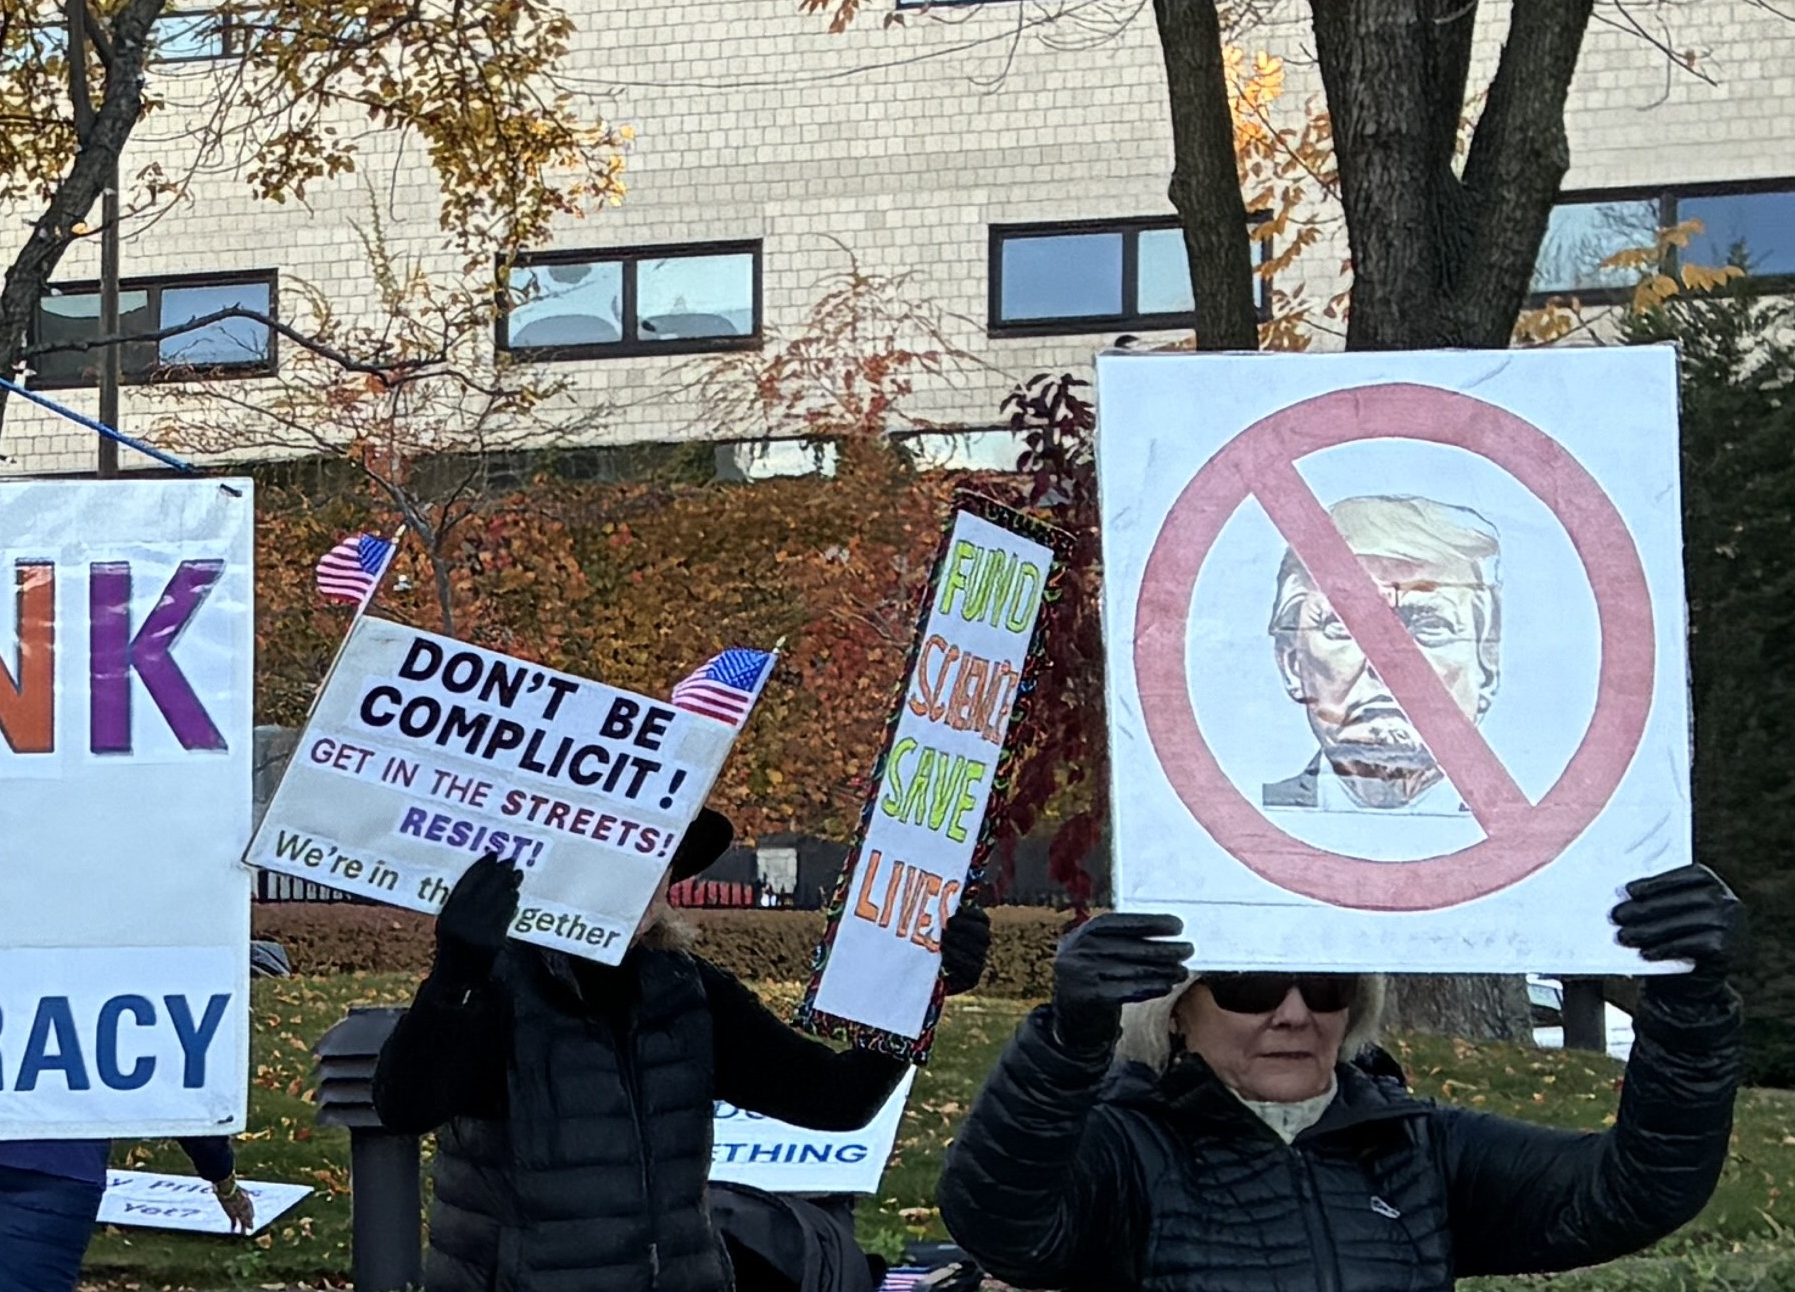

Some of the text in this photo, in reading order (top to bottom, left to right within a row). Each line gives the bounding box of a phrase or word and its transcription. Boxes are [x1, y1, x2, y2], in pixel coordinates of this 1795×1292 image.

[938, 537, 1042, 636] FUND
[358, 684, 689, 812] COMPLICIT!
[398, 636, 677, 752] DON'T BE
[310, 737, 677, 860] GET IN THE STREETS!
[398, 804, 546, 868] RESIST!
[880, 736, 987, 845] SAVE
[274, 828, 365, 881] We're
[368, 859, 400, 893] in
[512, 904, 621, 951] gether
[853, 849, 961, 954] LIVES
